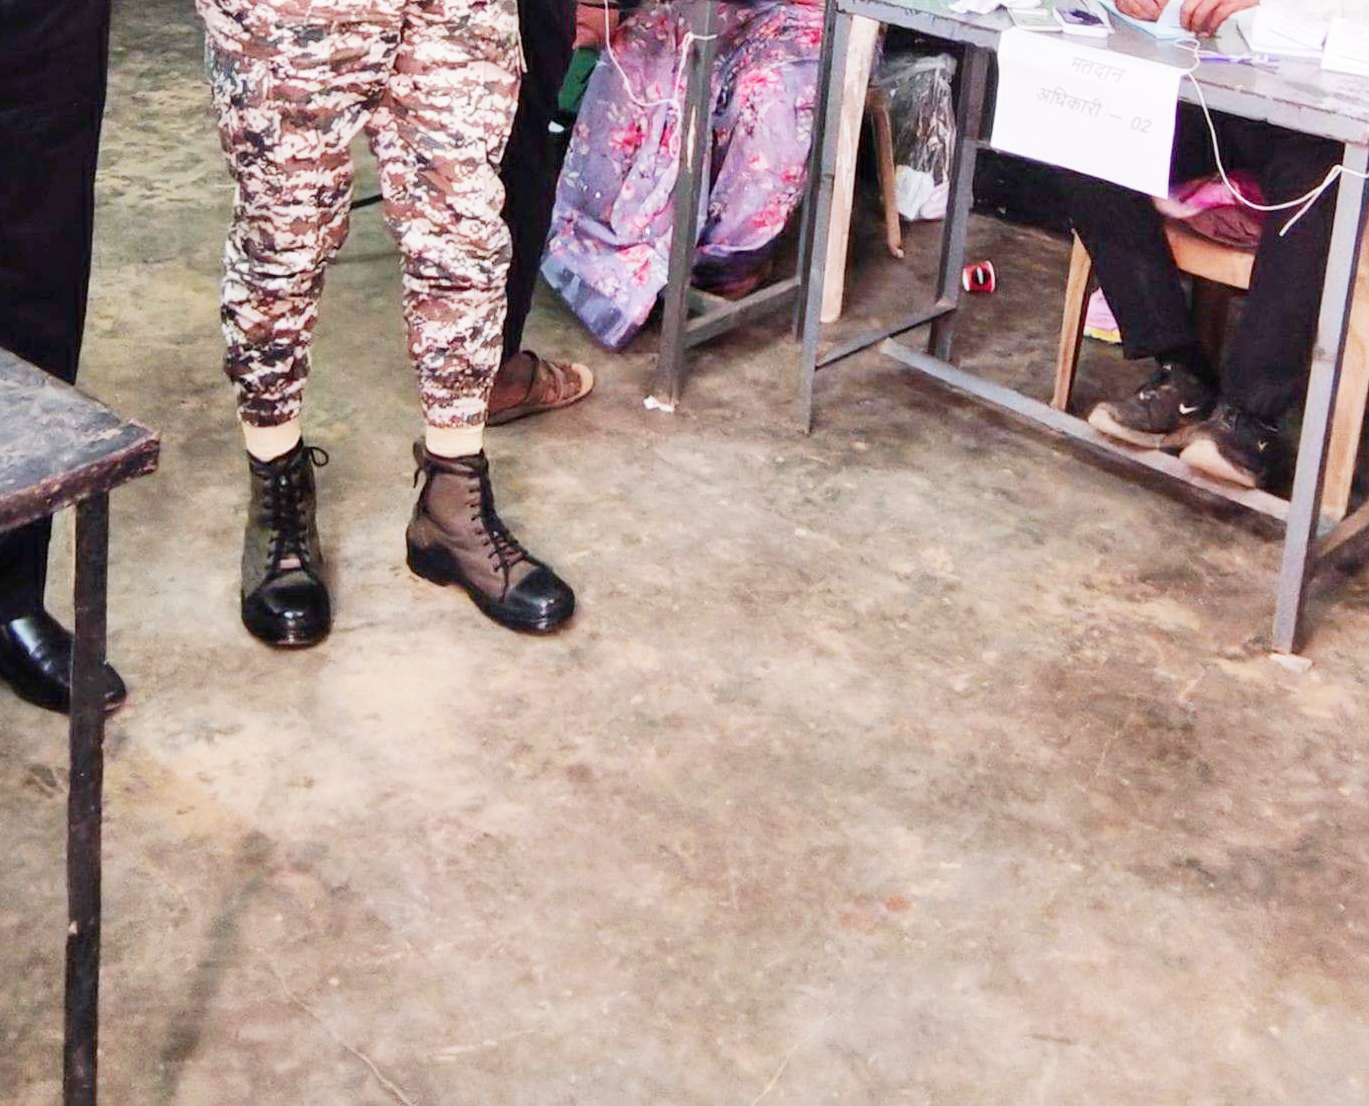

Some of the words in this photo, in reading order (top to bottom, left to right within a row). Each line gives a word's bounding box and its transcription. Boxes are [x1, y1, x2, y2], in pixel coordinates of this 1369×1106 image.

[1071, 56, 1127, 84] मतदान
[1036, 86, 1103, 118] अधिकारी
[1130, 116, 1152, 133] 02
